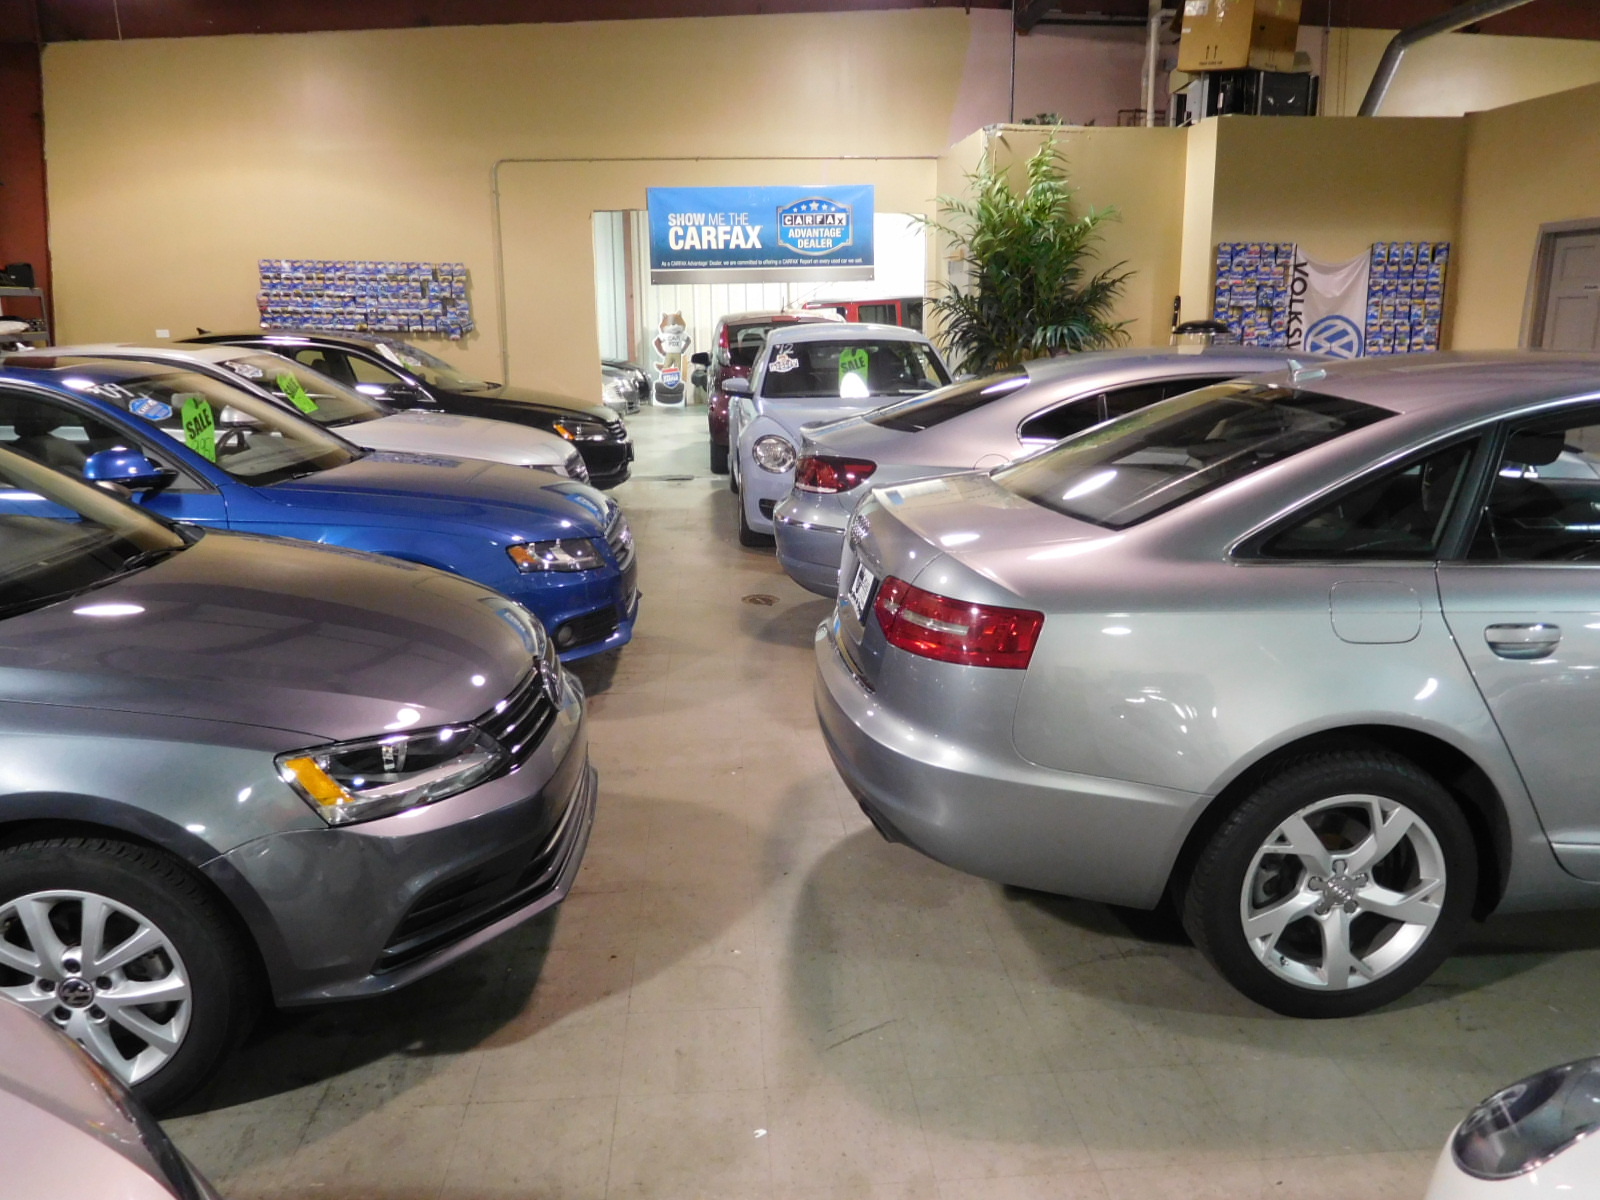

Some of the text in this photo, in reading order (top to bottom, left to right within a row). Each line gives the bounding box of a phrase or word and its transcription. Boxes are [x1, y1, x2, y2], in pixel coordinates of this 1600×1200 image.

[668, 213, 749, 226] SHOW ME THE
[784, 214, 844, 226] CARFAX
[669, 226, 762, 250] CARFAX
[788, 227, 842, 238] ADVANTAGE
[797, 238, 833, 248] DEALER
[1287, 262, 1309, 349] VOLKS
[841, 356, 866, 373] SALE
[186, 408, 211, 440] SALE
